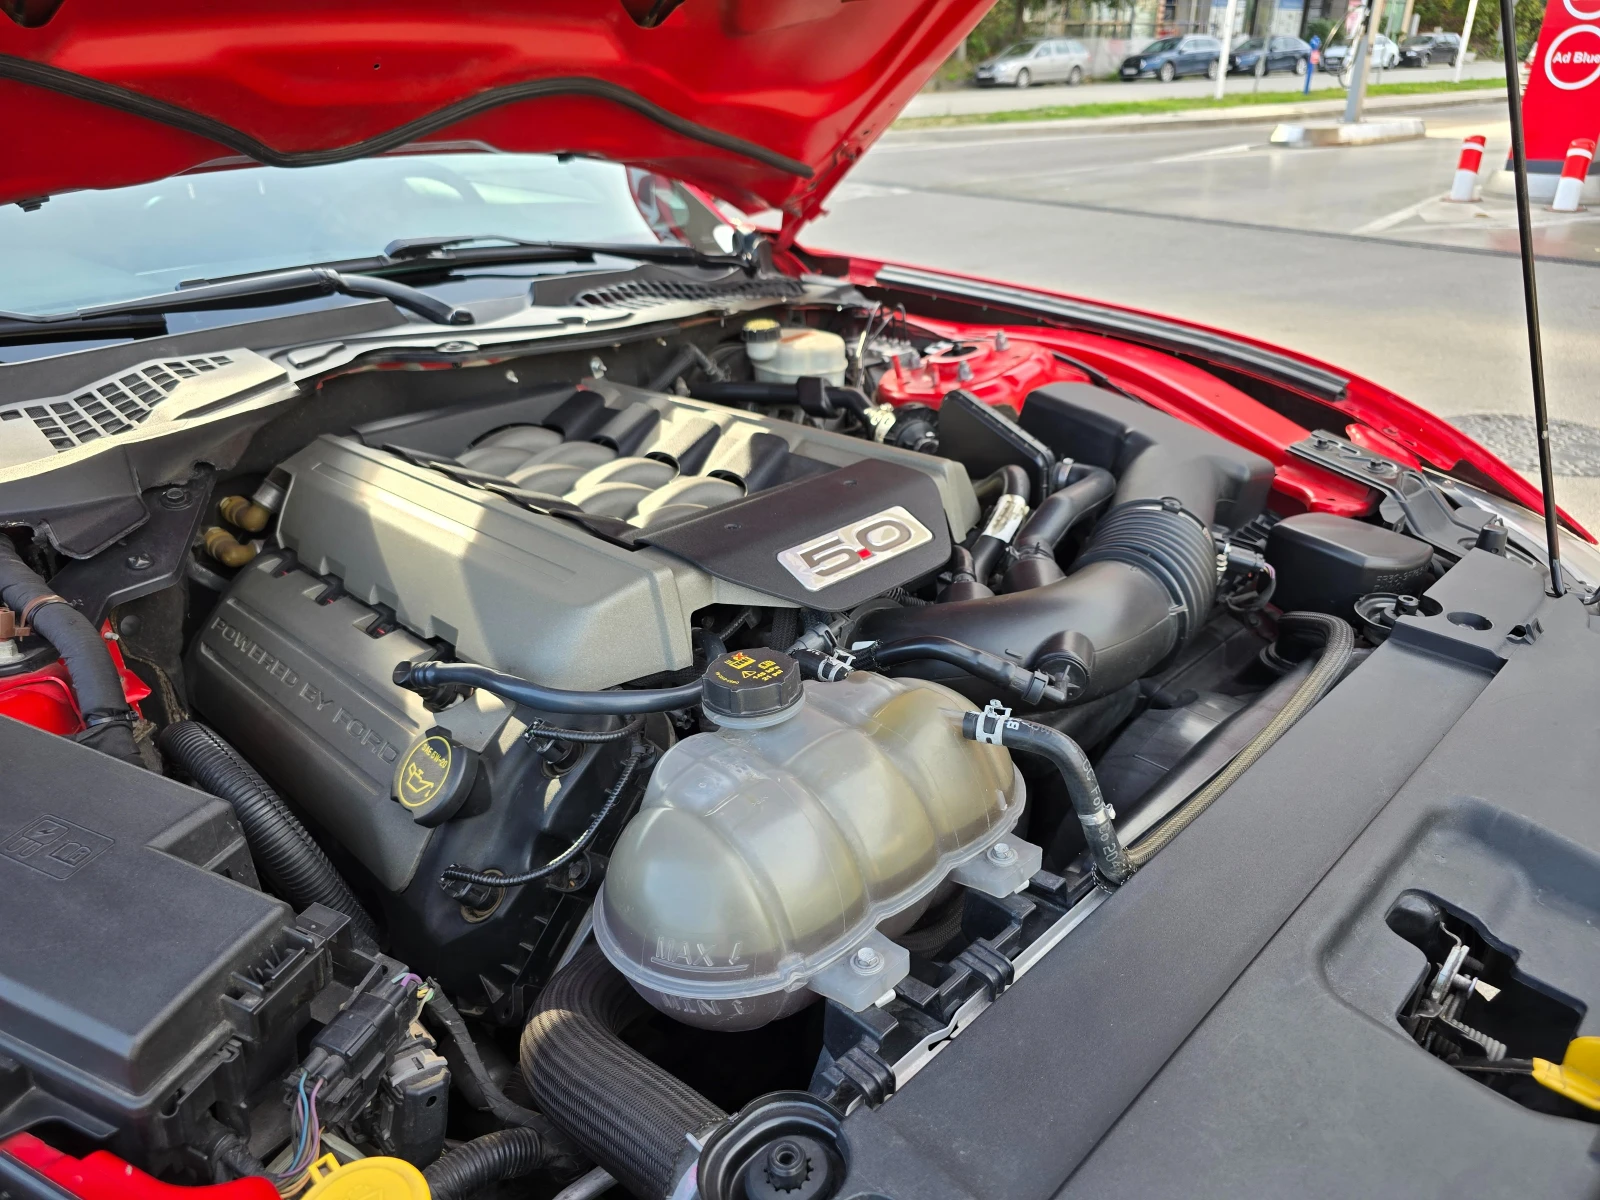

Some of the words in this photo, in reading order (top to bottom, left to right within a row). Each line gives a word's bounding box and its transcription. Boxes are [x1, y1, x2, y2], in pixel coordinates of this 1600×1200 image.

[1553, 51, 1571, 64] Ad
[799, 518, 912, 577] 5.0
[211, 616, 299, 688] POWERED
[299, 682, 334, 711] BY
[332, 707, 399, 765] FORD
[421, 743, 433, 756] SAE
[655, 936, 717, 966] MAX
[661, 992, 721, 1015] MIN
